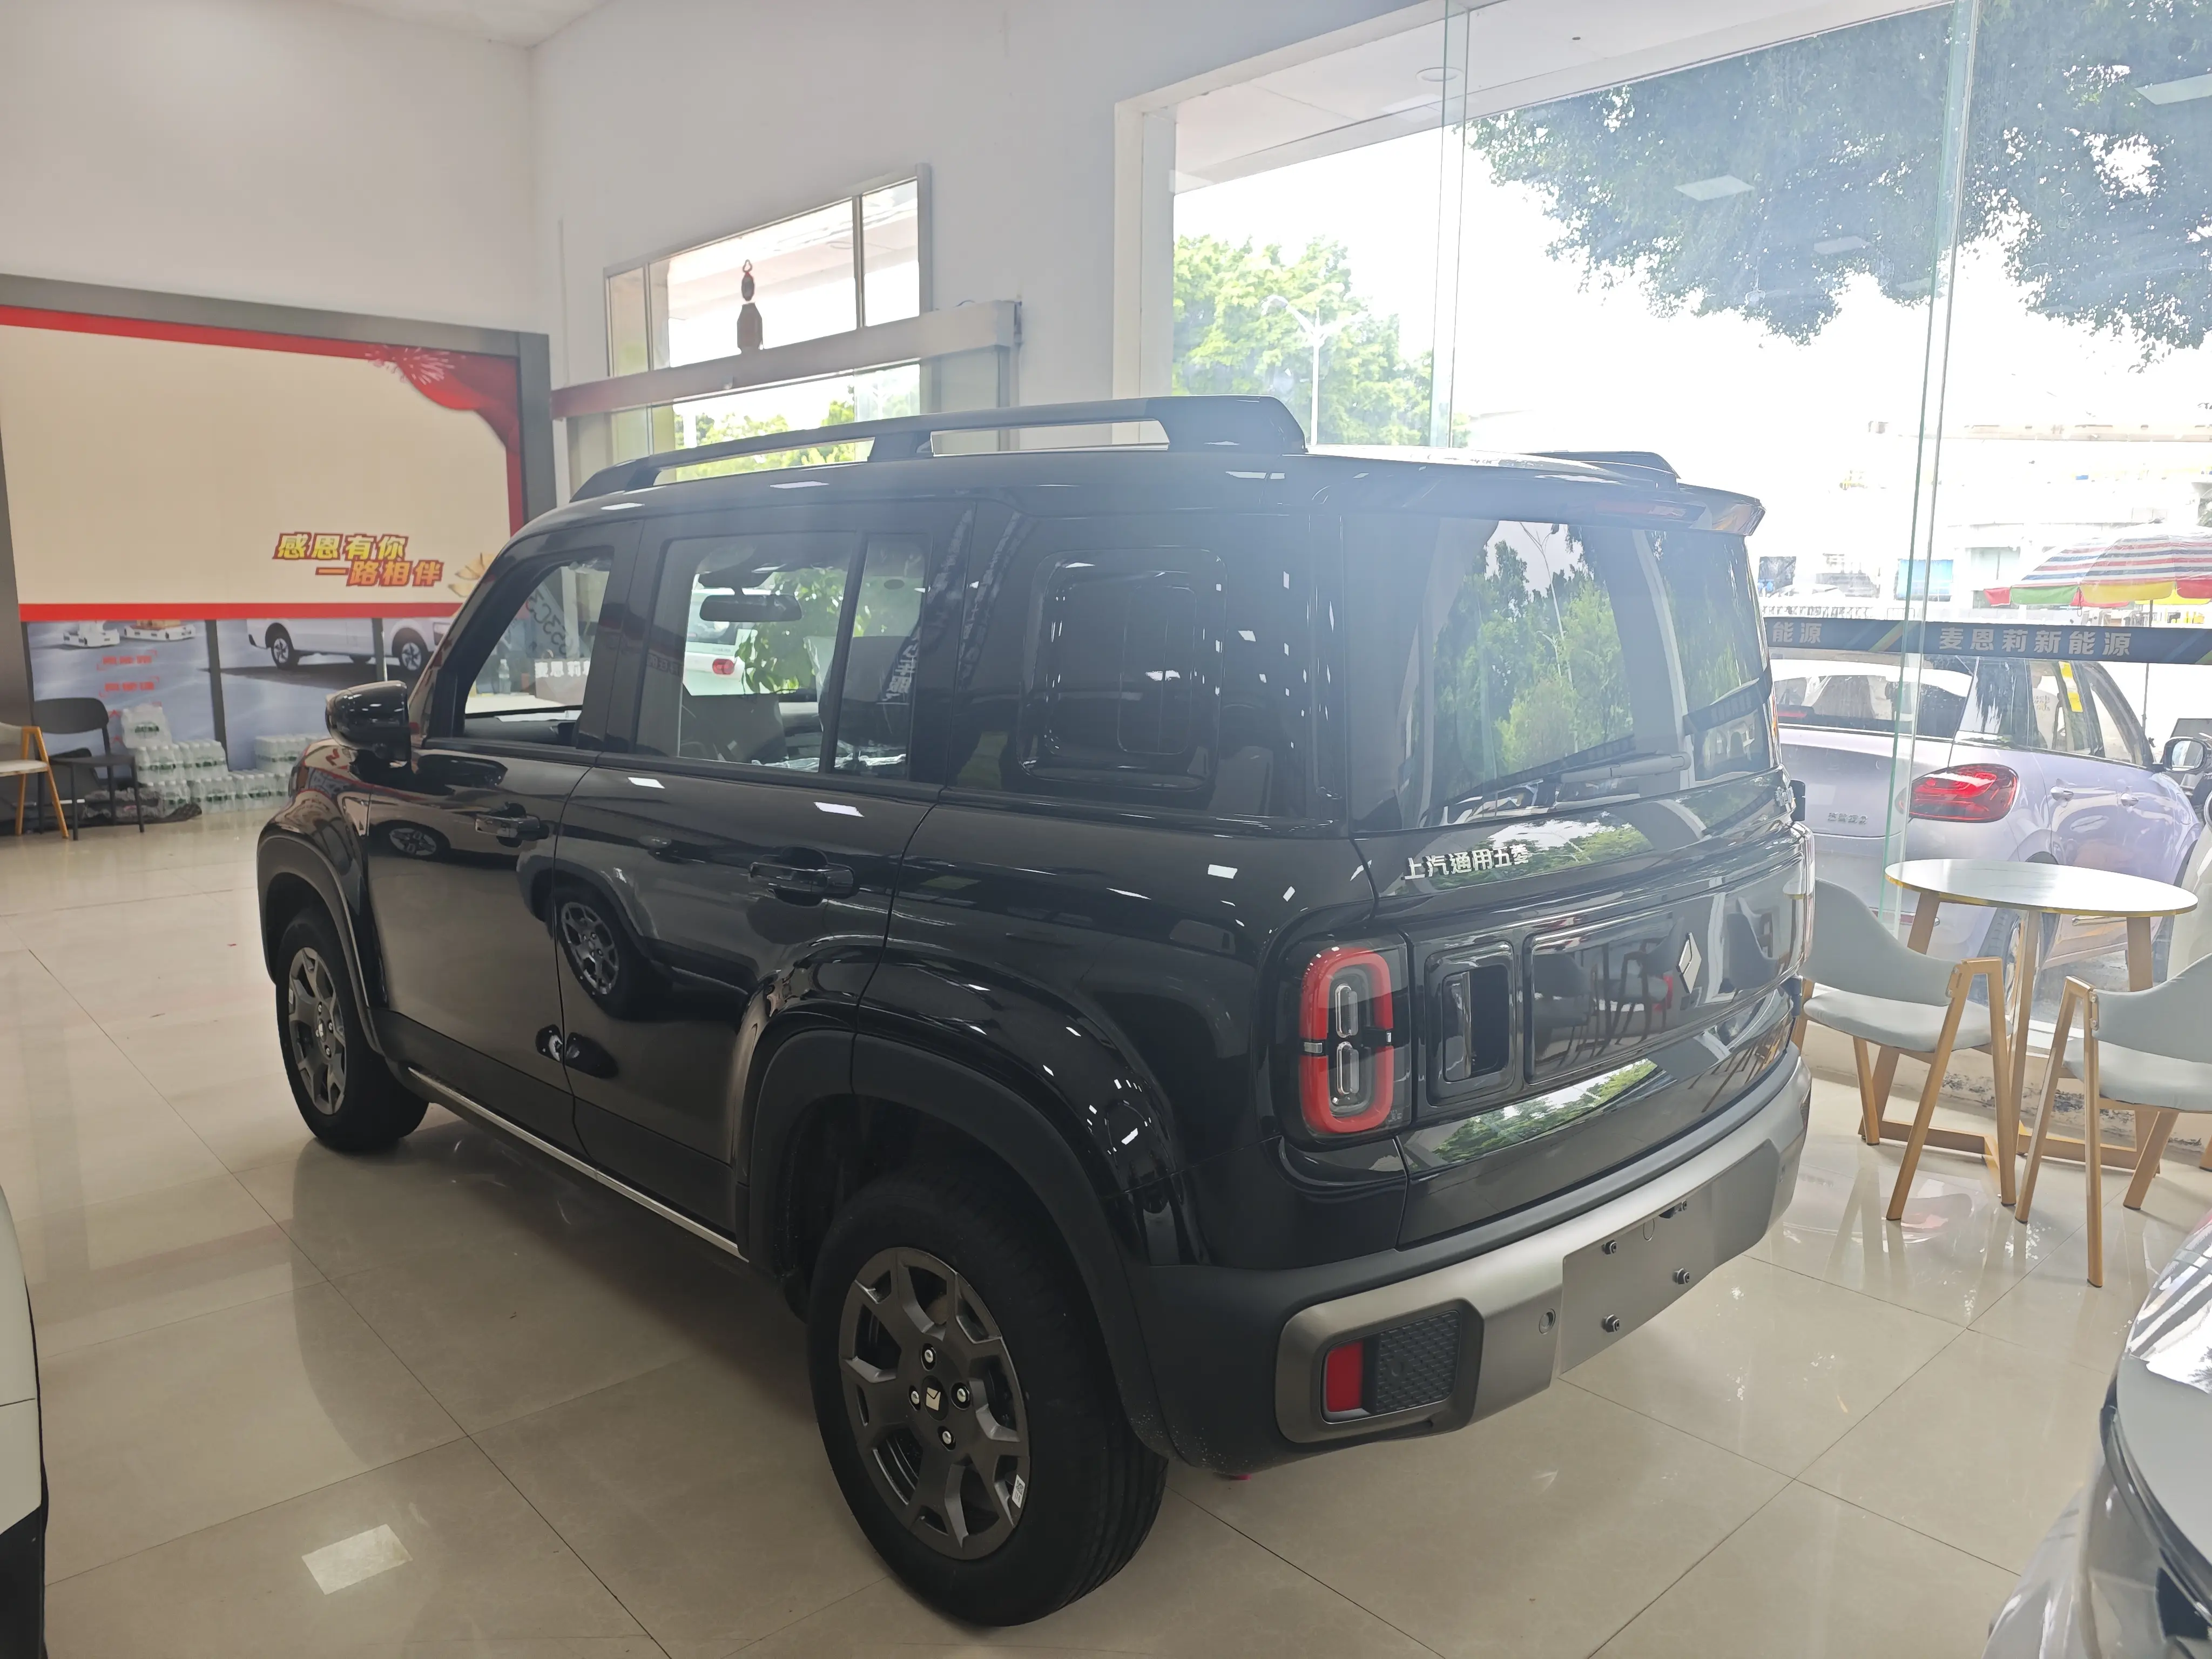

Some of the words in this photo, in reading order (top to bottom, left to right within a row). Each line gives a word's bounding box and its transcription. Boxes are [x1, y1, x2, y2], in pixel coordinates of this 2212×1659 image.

[273, 532, 408, 560] 感恩有你
[315, 559, 444, 586] 一路相伴
[1766, 622, 1822, 644] 能源
[1939, 627, 2132, 656] 麦恩莉新能源
[1404, 844, 1529, 880] 上汽通用五菱
